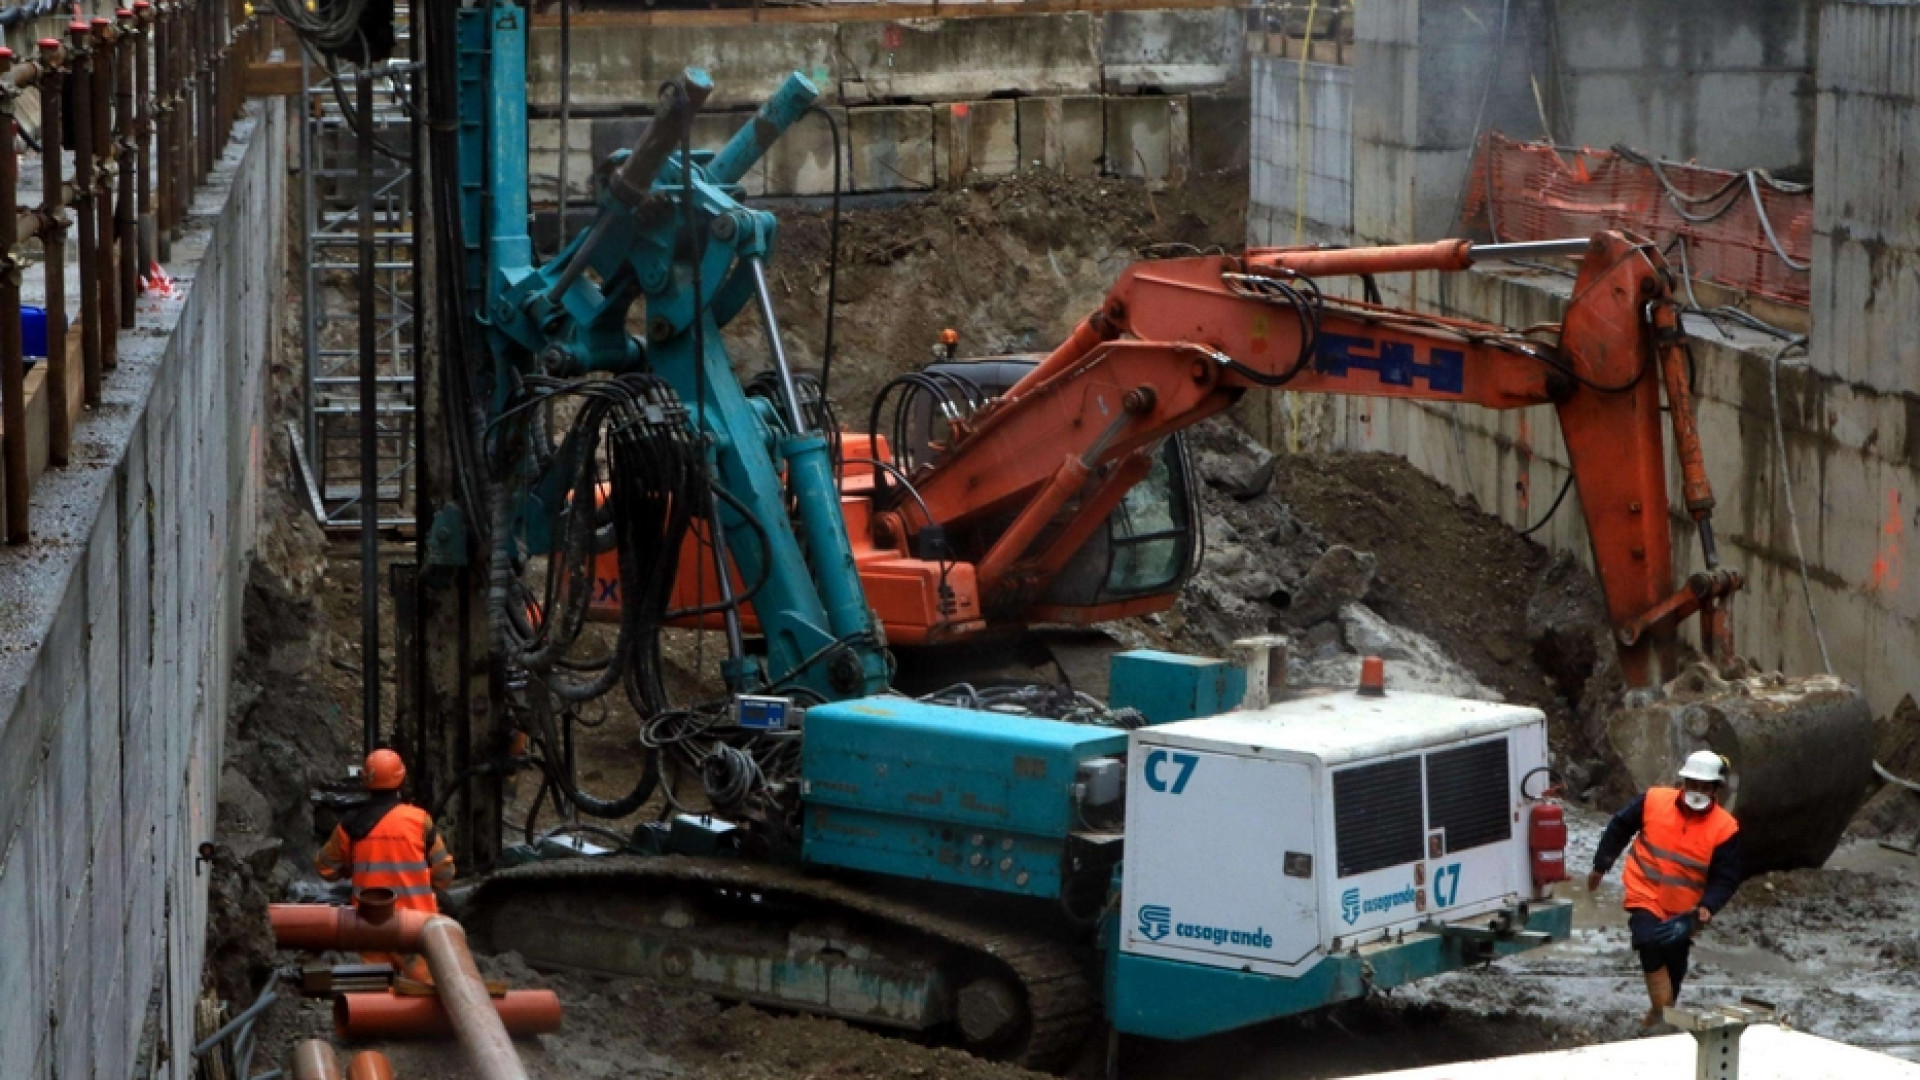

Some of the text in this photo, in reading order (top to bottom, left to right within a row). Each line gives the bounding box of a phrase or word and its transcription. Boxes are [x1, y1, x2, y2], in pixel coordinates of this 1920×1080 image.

[1145, 750, 1200, 795] C7
[1433, 862, 1461, 908] C7
[1176, 922, 1273, 949] casagrande
